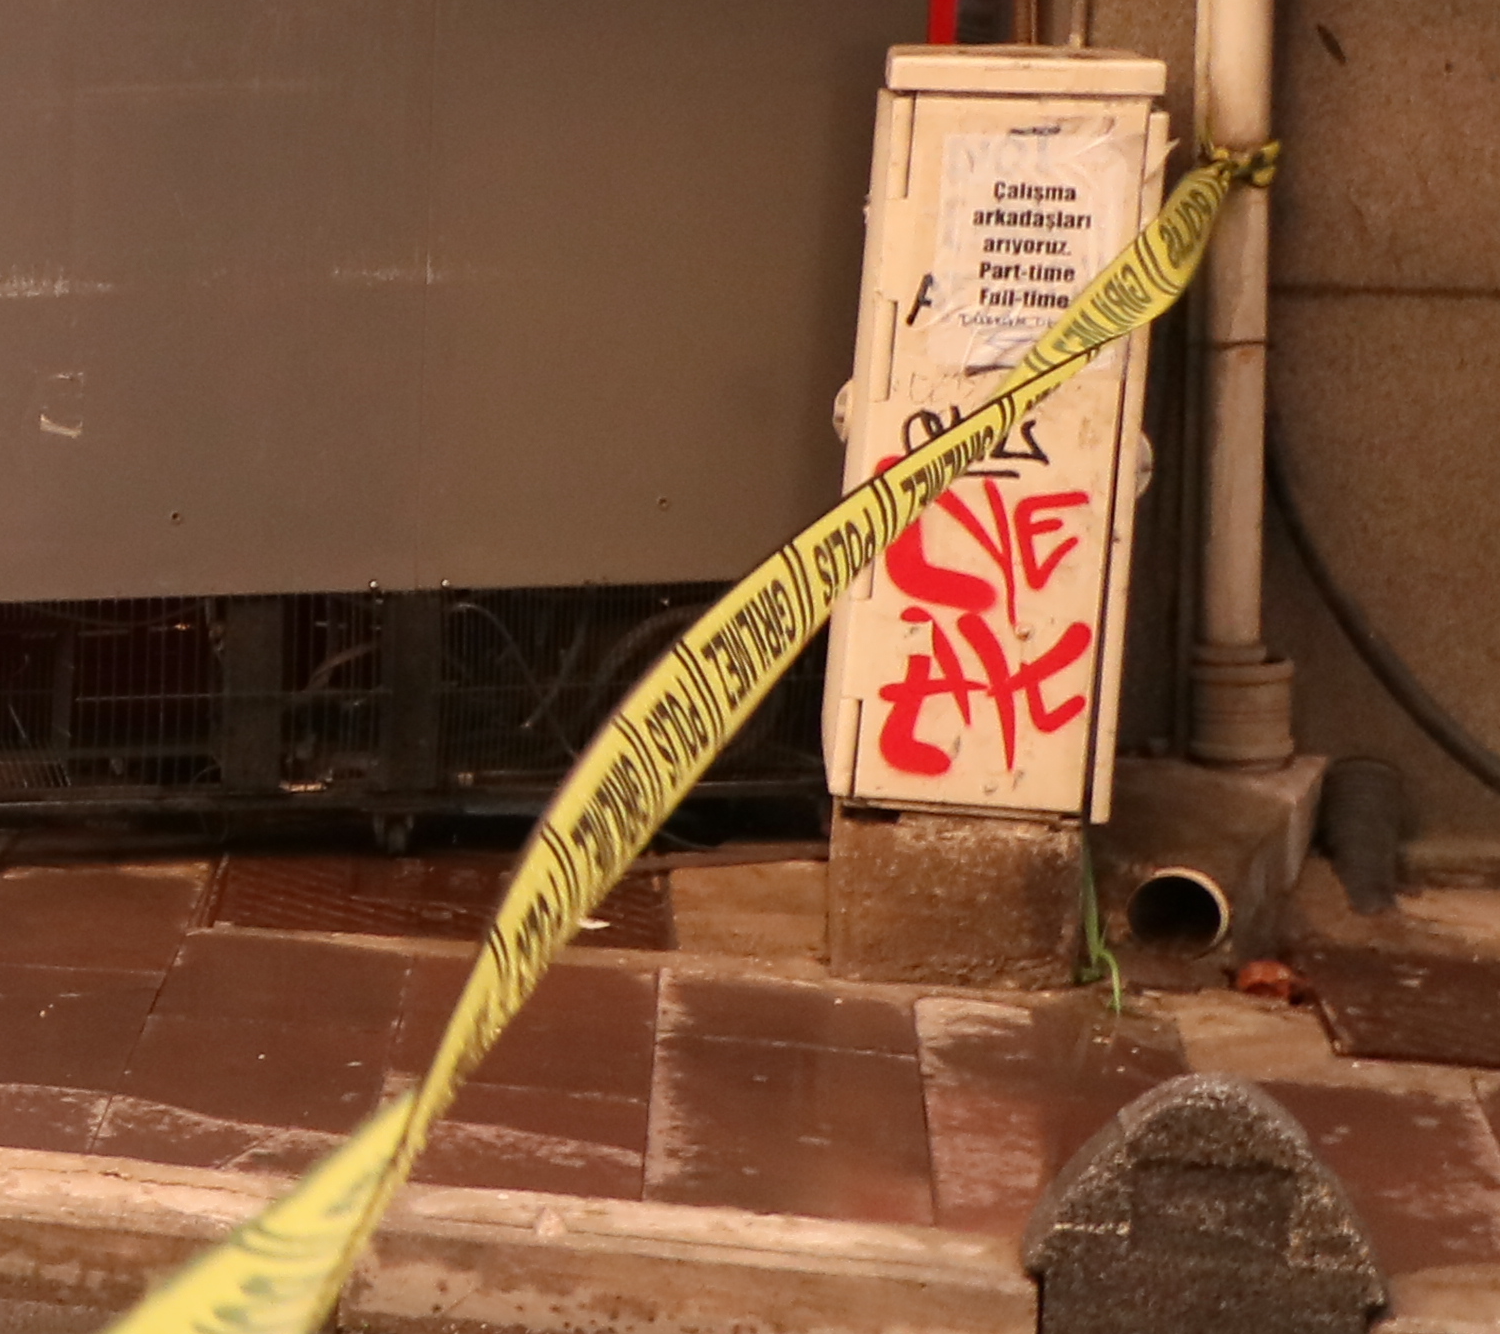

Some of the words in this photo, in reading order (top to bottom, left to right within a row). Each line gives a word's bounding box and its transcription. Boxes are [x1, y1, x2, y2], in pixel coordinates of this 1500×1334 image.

[993, 180, 1077, 206] Çalışma
[972, 208, 1092, 232] arkadaşları
[982, 237, 1072, 256] arıyoruz.
[978, 260, 1076, 283] Part-time
[978, 287, 1071, 310] Full-time
[700, 570, 800, 715] GİRİLMEZ
